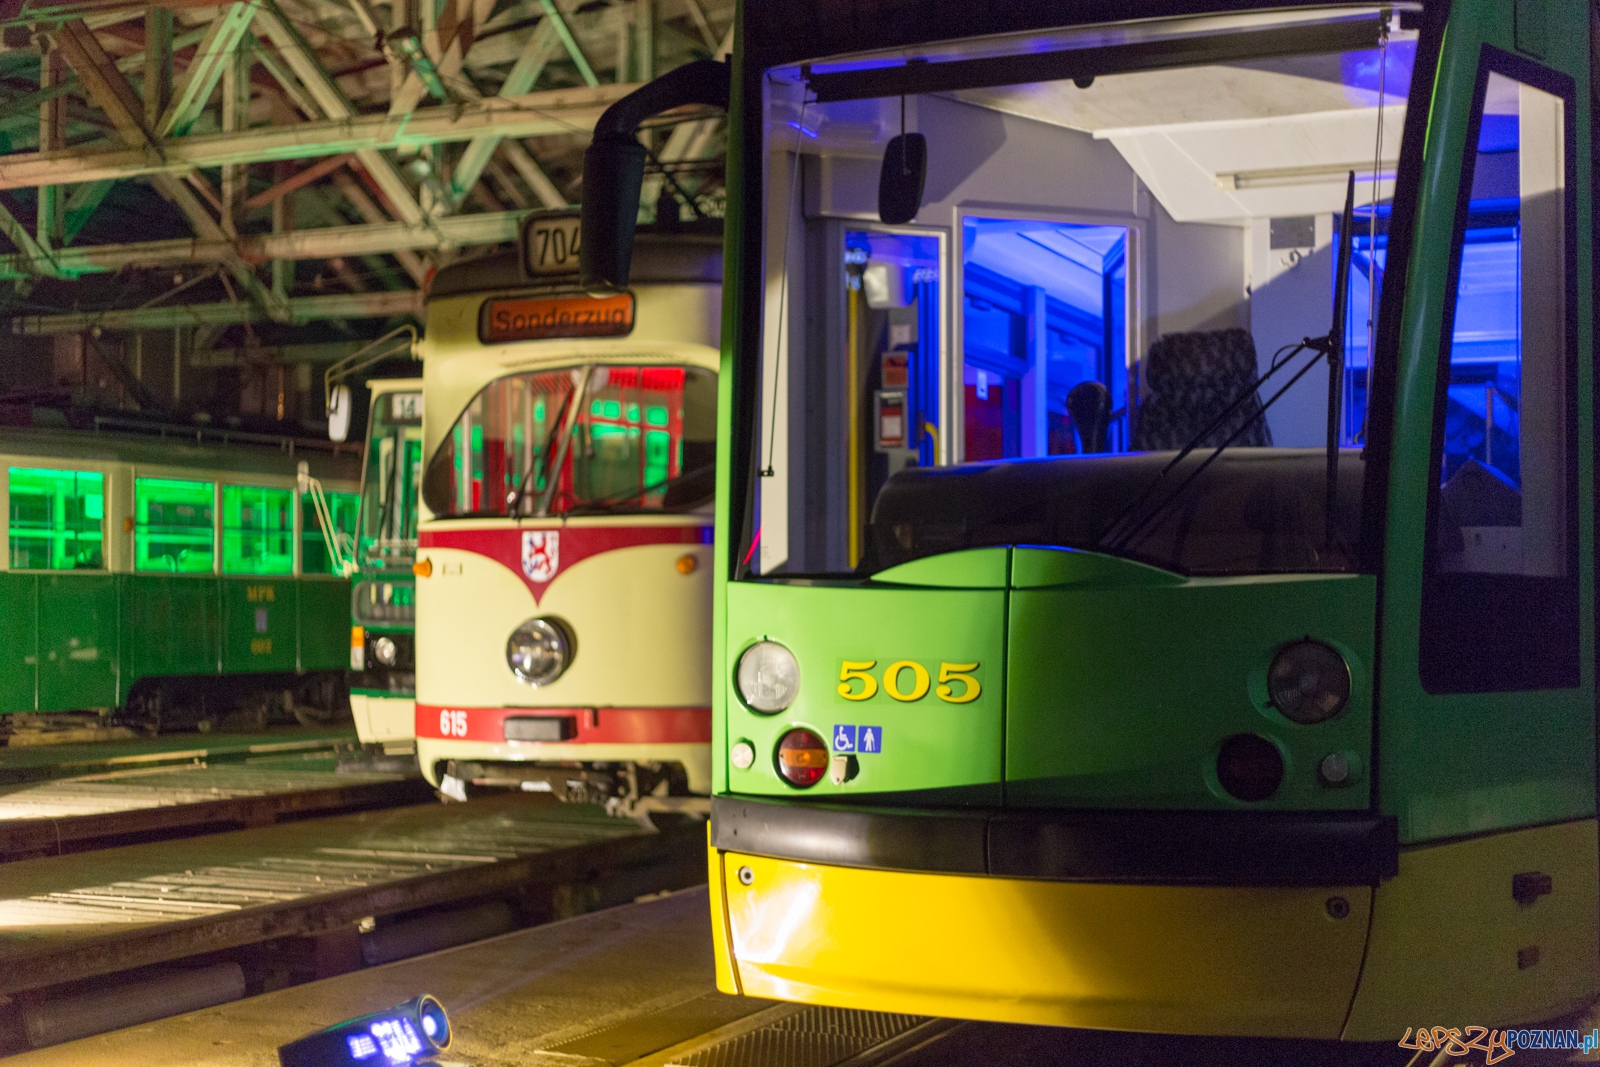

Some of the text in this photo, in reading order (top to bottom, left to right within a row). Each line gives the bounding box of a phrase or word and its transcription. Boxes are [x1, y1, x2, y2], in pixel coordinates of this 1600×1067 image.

[496, 306, 626, 332] Sonderzug
[837, 660, 982, 704] 505
[440, 709, 468, 737] 615
